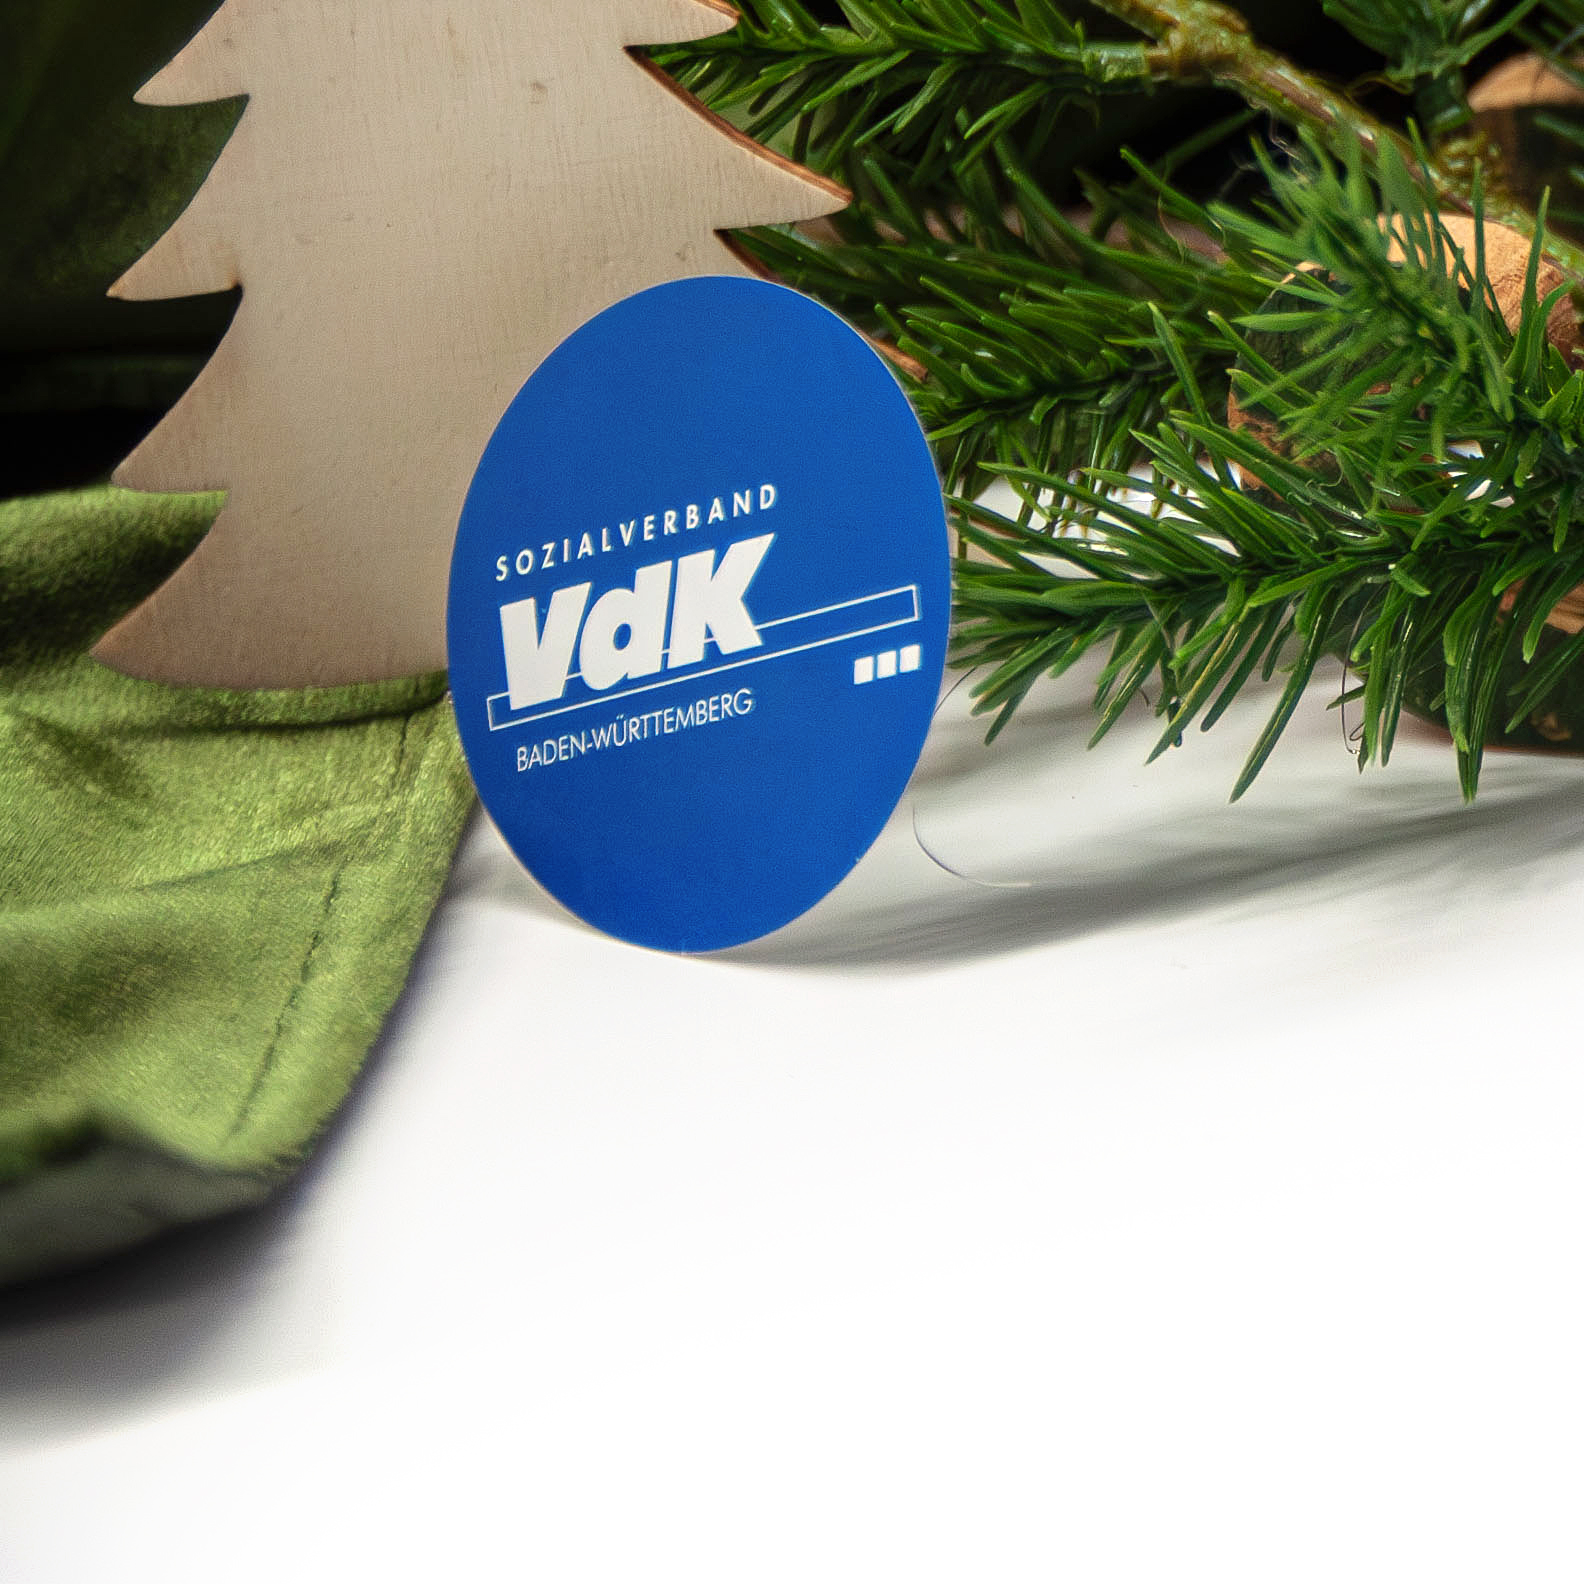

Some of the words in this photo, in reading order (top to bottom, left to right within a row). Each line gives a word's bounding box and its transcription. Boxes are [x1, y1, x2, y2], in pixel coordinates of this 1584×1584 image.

[496, 483, 778, 582] SOZIALVERBAND
[499, 532, 776, 711] VdK
[515, 687, 754, 773] BADEN-WÜRTTEMBERG
